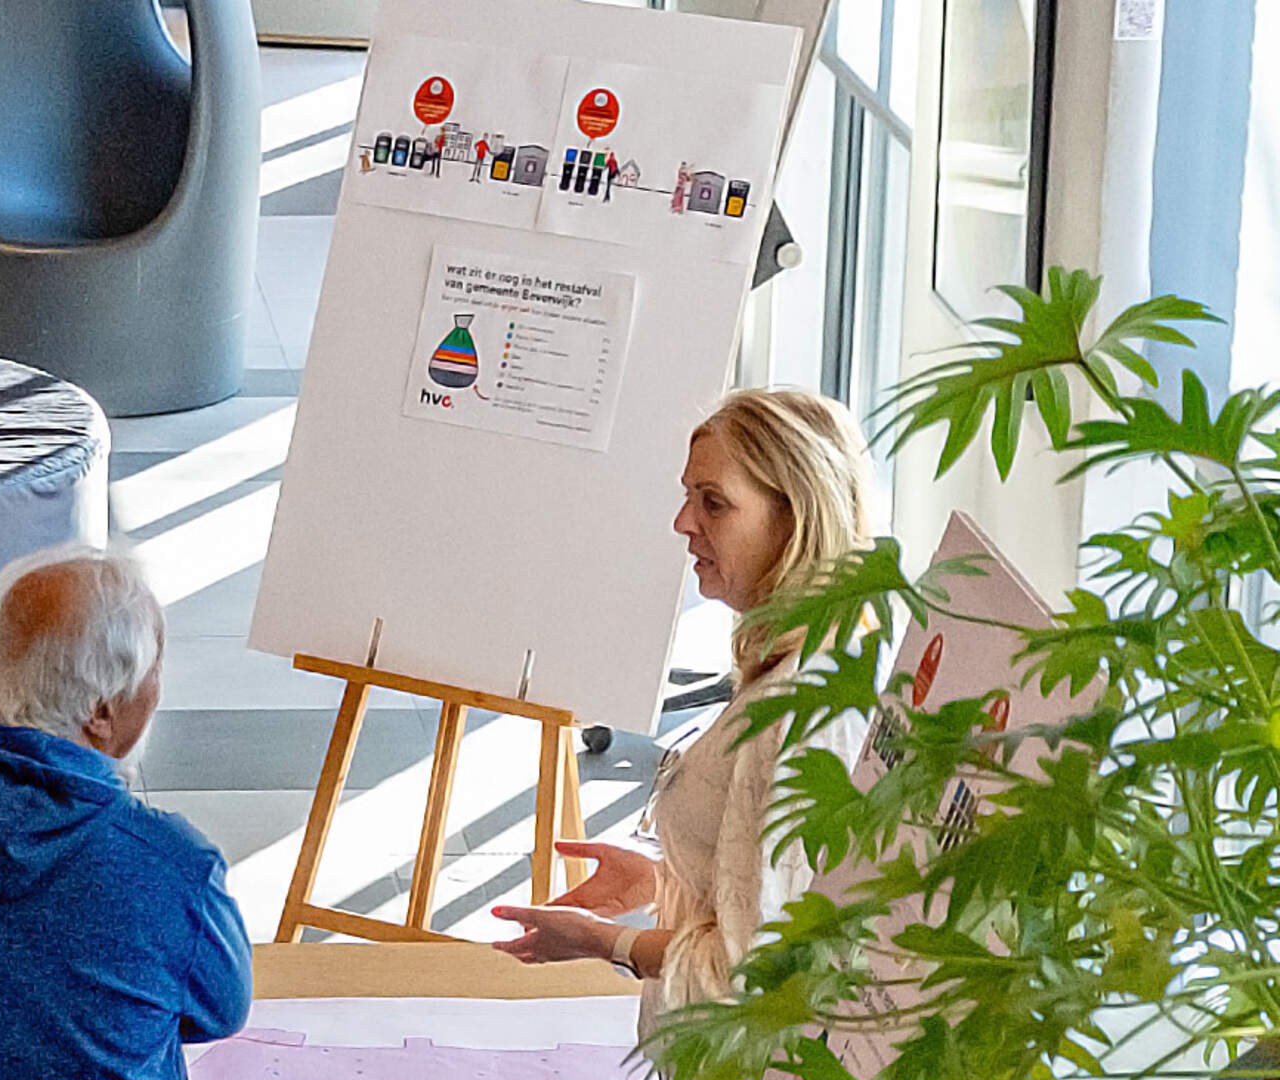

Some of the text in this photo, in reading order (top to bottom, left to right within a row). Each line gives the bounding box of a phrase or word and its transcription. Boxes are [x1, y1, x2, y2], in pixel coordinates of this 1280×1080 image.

[444, 278, 463, 289] van
[465, 283, 520, 299] gemeente
[446, 263, 603, 298] wat zit er nog in het restafval
